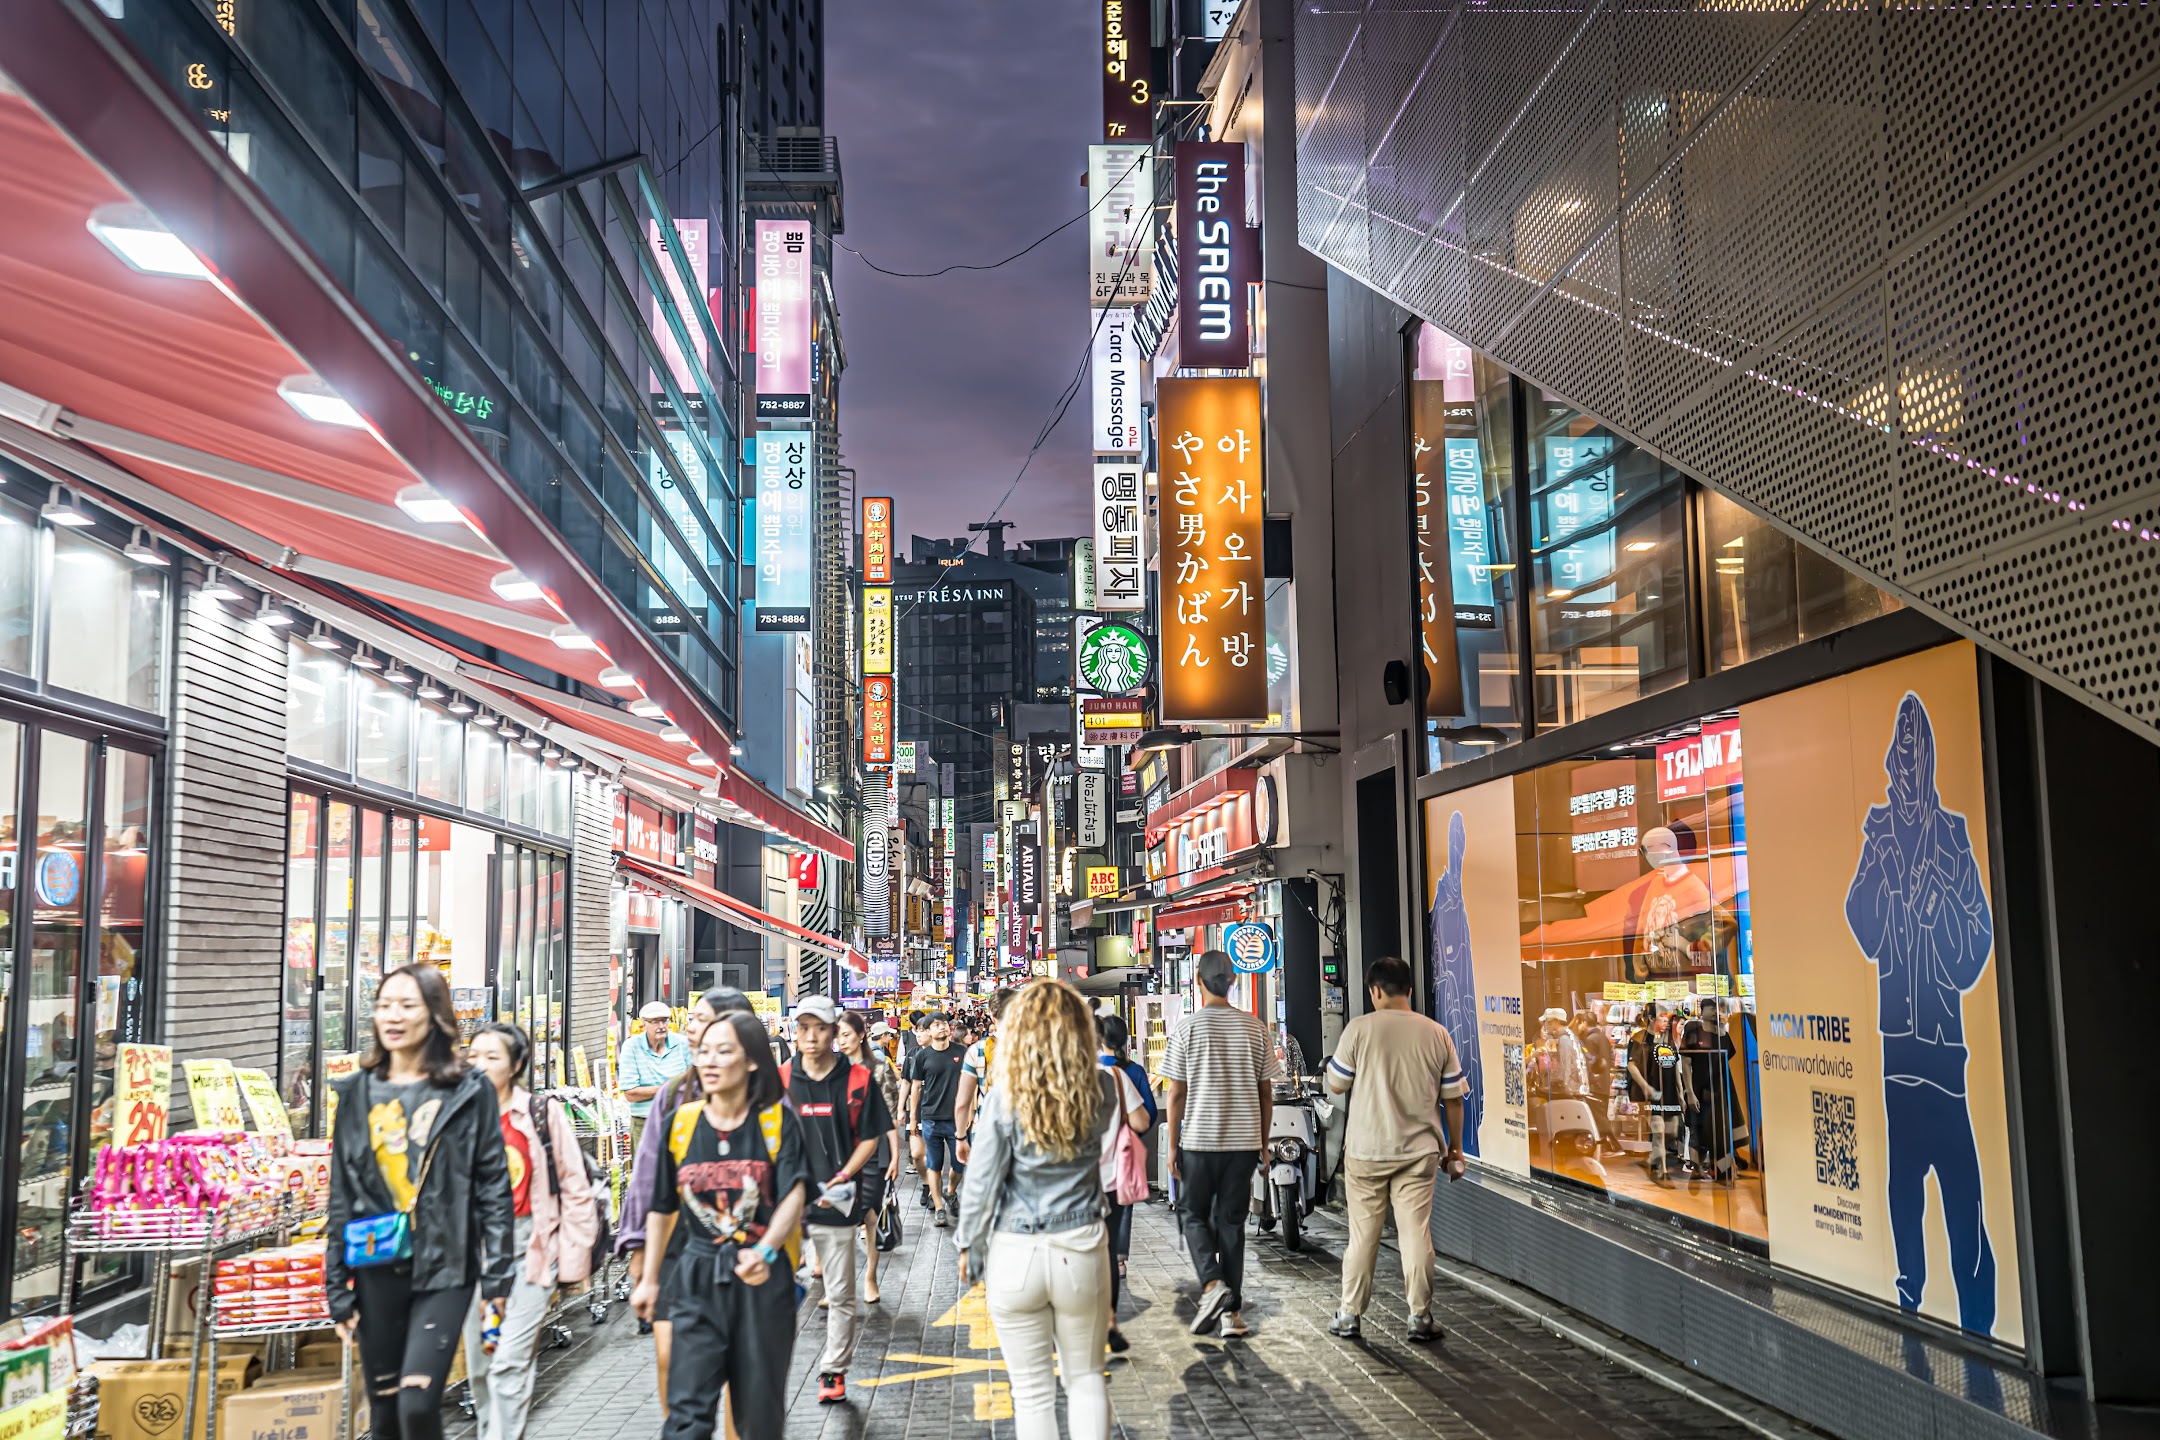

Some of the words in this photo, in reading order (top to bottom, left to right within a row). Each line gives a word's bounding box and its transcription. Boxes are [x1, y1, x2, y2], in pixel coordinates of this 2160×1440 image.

[1106, 0, 1127, 81] 준오헤어
[1131, 80, 1149, 104] 3
[1108, 123, 1126, 136] 7F
[1197, 161, 1228, 212] the
[784, 232, 805, 253] 쁨
[1096, 286, 1111, 297] 6F
[1198, 220, 1231, 340] SAEM
[761, 230, 782, 373] 명동예쁨주의
[760, 401, 805, 409] 752-8887
[1108, 370, 1125, 448] Massage
[785, 442, 806, 489] 상상
[761, 441, 782, 585] 명동예쁨주의
[868, 530, 885, 565] 牛肉面
[1101, 472, 1139, 600] 명동피자
[1171, 430, 1212, 668] やさ男かばん
[1216, 429, 1255, 668] 야사오가방
[917, 585, 973, 603] FRÉSA
[977, 589, 1003, 600] INN
[760, 615, 805, 624] 753-8886
[1089, 702, 1112, 710] JUNO
[1115, 701, 1138, 710] HAIR
[1084, 775, 1097, 844] 장인닭갈비
[1022, 845, 1034, 903] ARITAUM
[1091, 873, 1115, 884] ABC
[1091, 885, 1116, 893] MART
[867, 976, 895, 988] BAR
[1501, 996, 1521, 1015] TRIBE
[1769, 1013, 1805, 1040] MCM
[1807, 1014, 1852, 1044] TRIBE
[1762, 1050, 1854, 1080] @mcmworldwide
[1813, 1204, 1862, 1227] #MCMIDENTITIES
[1837, 1195, 1861, 1212] Discover
[1815, 1219, 1835, 1236] starring
